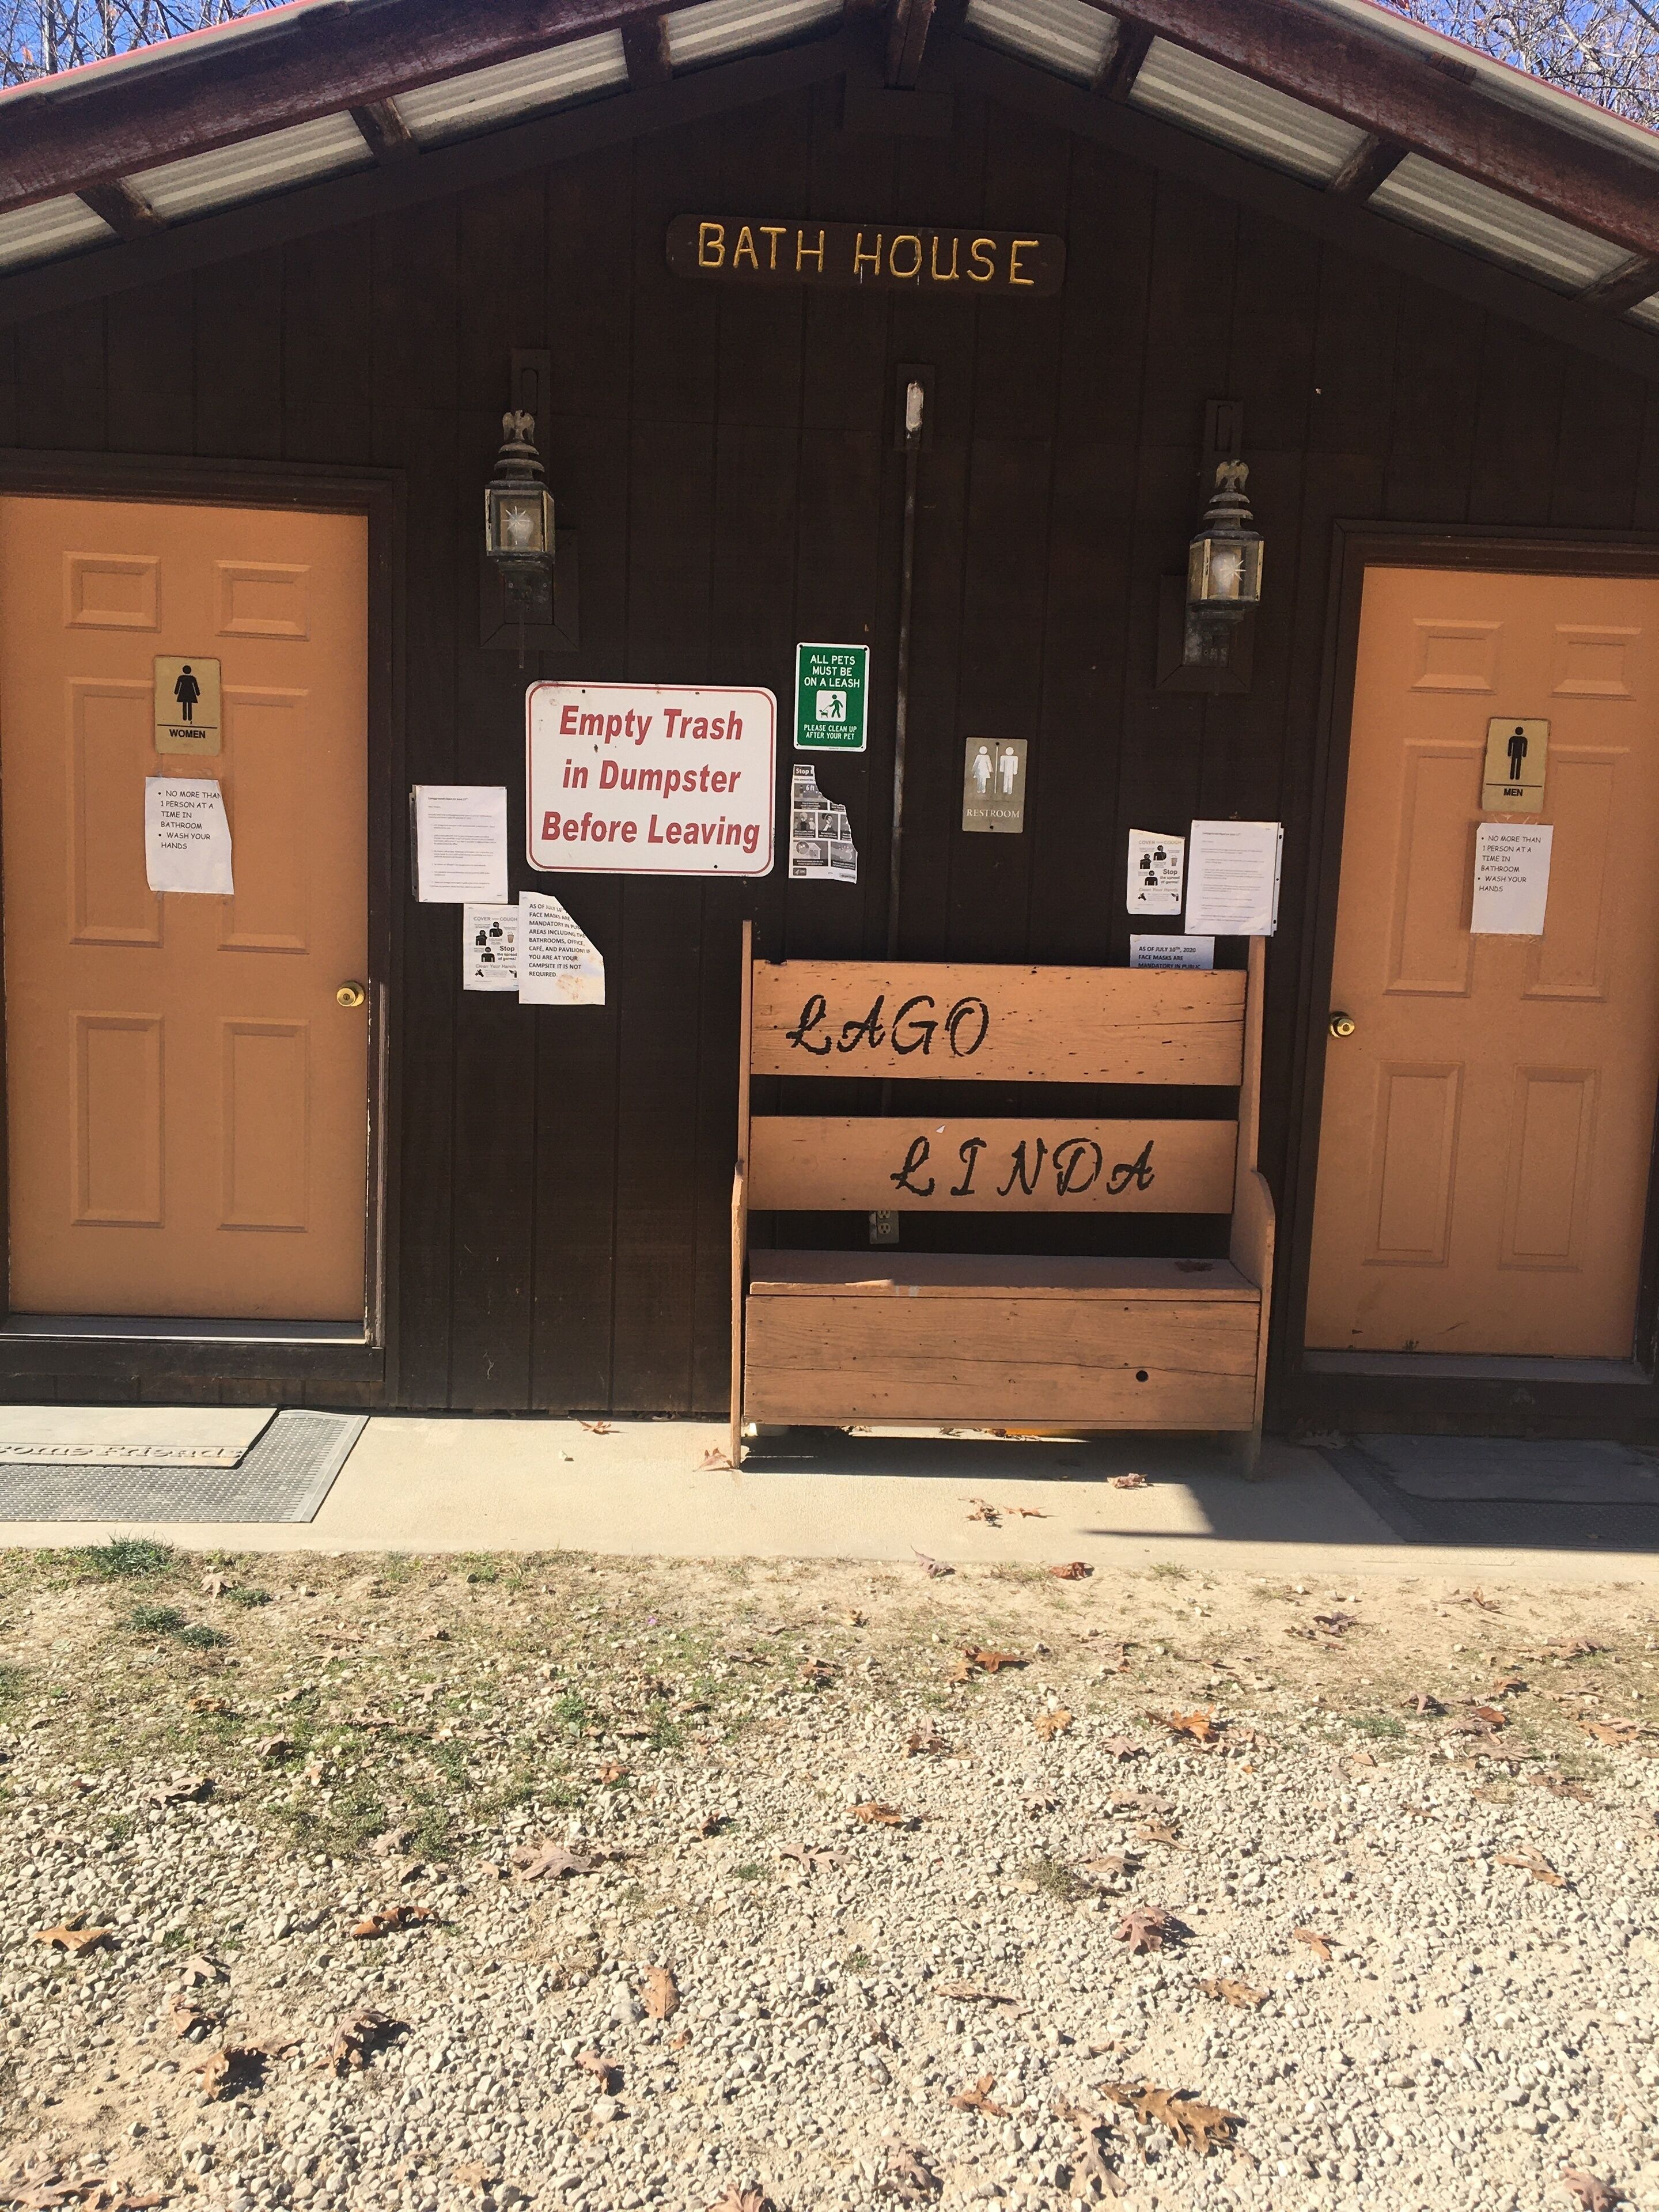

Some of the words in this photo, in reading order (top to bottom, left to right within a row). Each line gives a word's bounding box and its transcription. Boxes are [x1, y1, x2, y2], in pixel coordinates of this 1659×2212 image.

[699, 222, 825, 272] BATH
[854, 233, 1039, 285] HOUSE
[810, 654, 828, 664] ALL
[831, 656, 855, 665] PETS
[812, 666, 837, 676] MUST
[840, 667, 852, 676] BE
[804, 677, 817, 686] ON
[820, 678, 827, 687] A
[829, 678, 860, 688] LEASH
[560, 706, 652, 745] Empty
[664, 709, 743, 740] Trash
[169, 729, 206, 739] WOMEN
[563, 759, 588, 789] in
[599, 760, 741, 798] Dumpster
[1503, 788, 1523, 797] MEN
[967, 809, 1020, 818] RESTROOM
[161, 821, 202, 830] BATHROOM
[541, 811, 637, 843] Before
[647, 814, 760, 854] Leaving
[548, 929, 576, 937] INCLUDING
[786, 994, 990, 1056] LAGO
[891, 1136, 1155, 1196] LINDA
[96, 1446, 244, 1458] Friends
